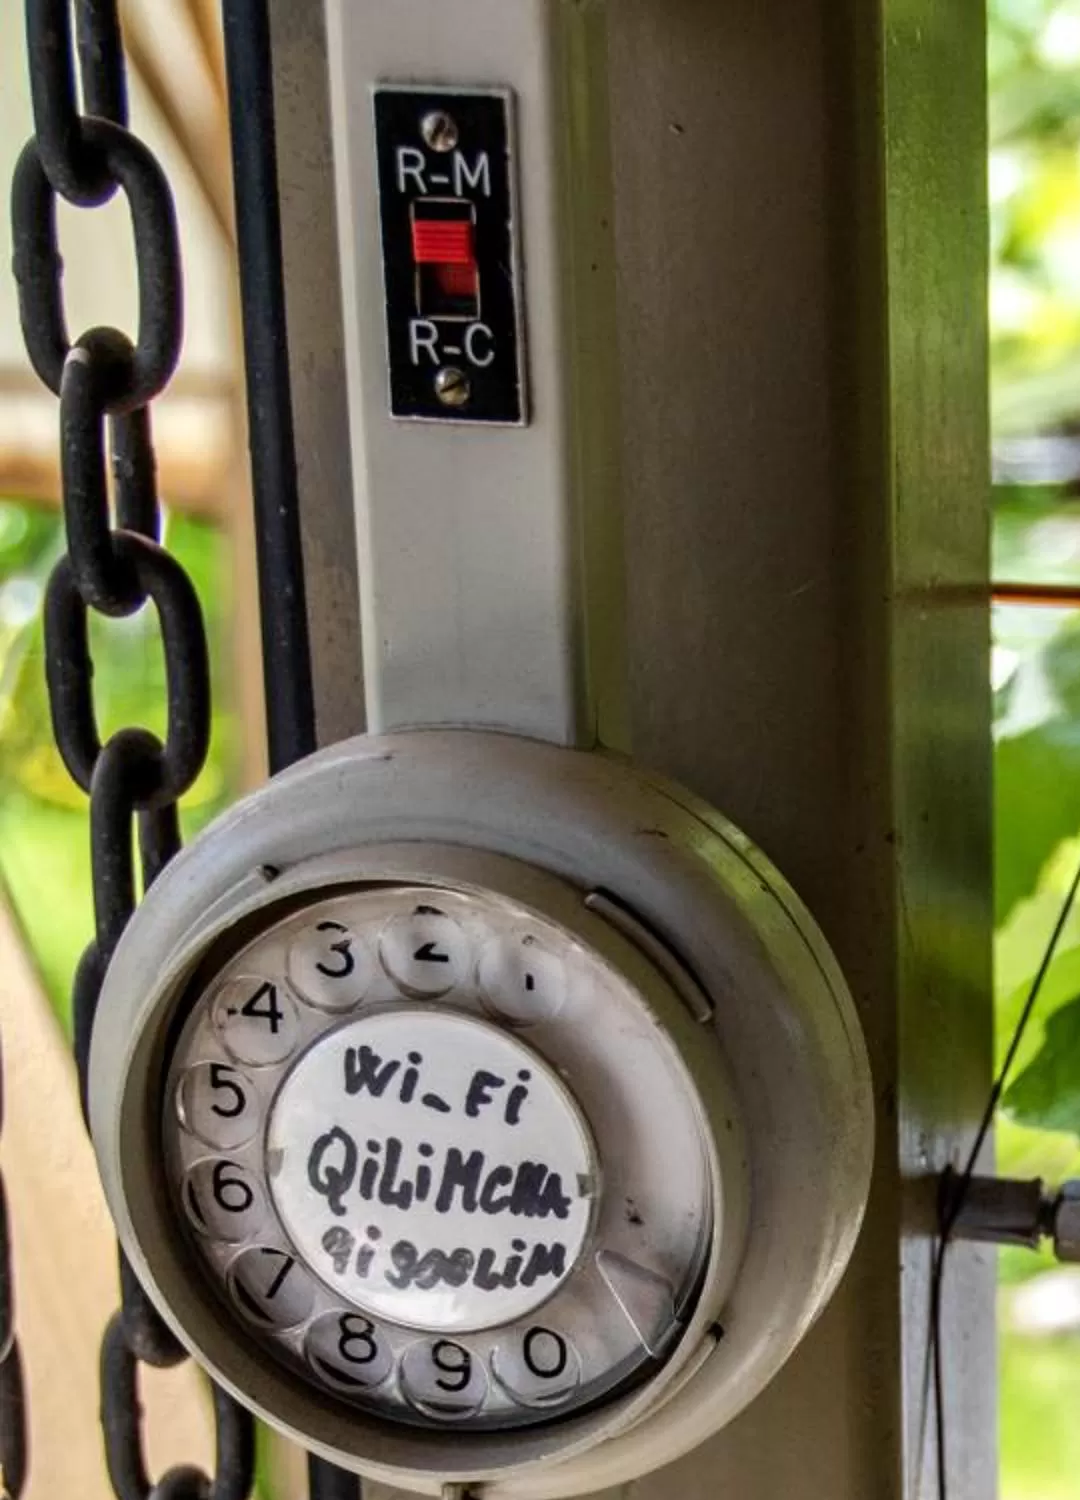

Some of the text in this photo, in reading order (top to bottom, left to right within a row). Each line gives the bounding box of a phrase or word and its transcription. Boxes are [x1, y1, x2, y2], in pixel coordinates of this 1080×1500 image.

[395, 146, 492, 197] R-M
[409, 318, 495, 367] R-C
[316, 922, 354, 978] 3
[241, 982, 284, 1033] 4
[210, 1063, 246, 1117] 5
[213, 1160, 254, 1213] 6
[260, 1247, 295, 1299] 7
[339, 1312, 377, 1364] 8
[523, 1325, 567, 1378] 0
[431, 1339, 471, 1391] 9
